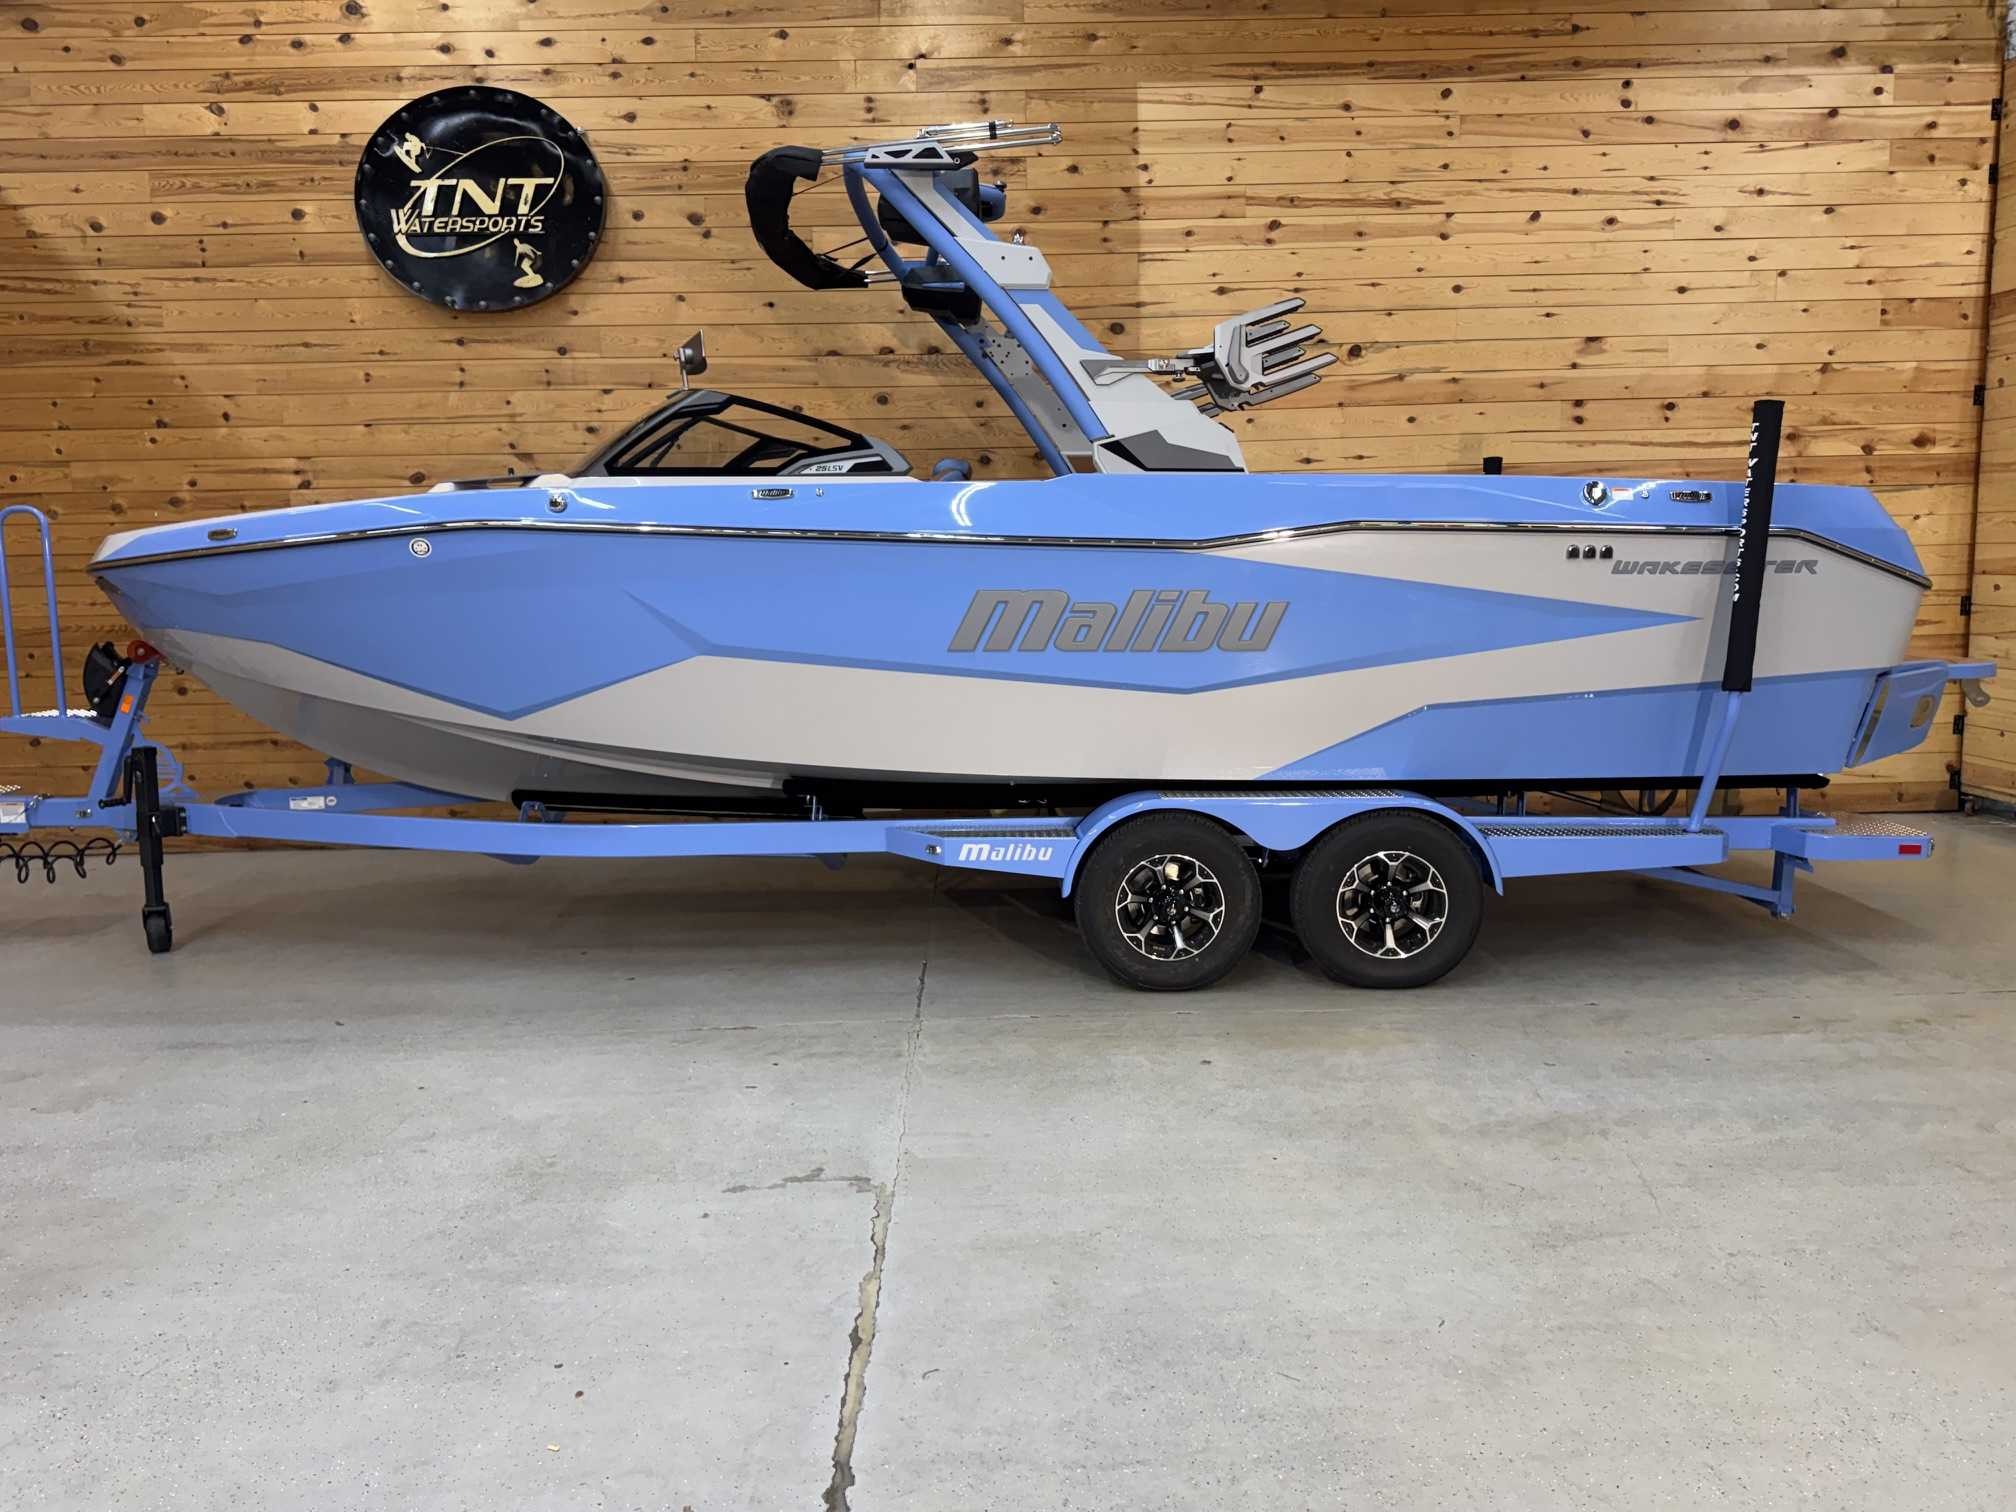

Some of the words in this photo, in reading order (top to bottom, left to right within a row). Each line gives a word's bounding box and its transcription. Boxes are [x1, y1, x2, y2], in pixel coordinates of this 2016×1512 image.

[410, 177, 554, 216] TNT
[390, 208, 546, 235] WATERSPORTS
[947, 588, 1291, 652] Malibu
[958, 843, 1053, 861] Malibu
